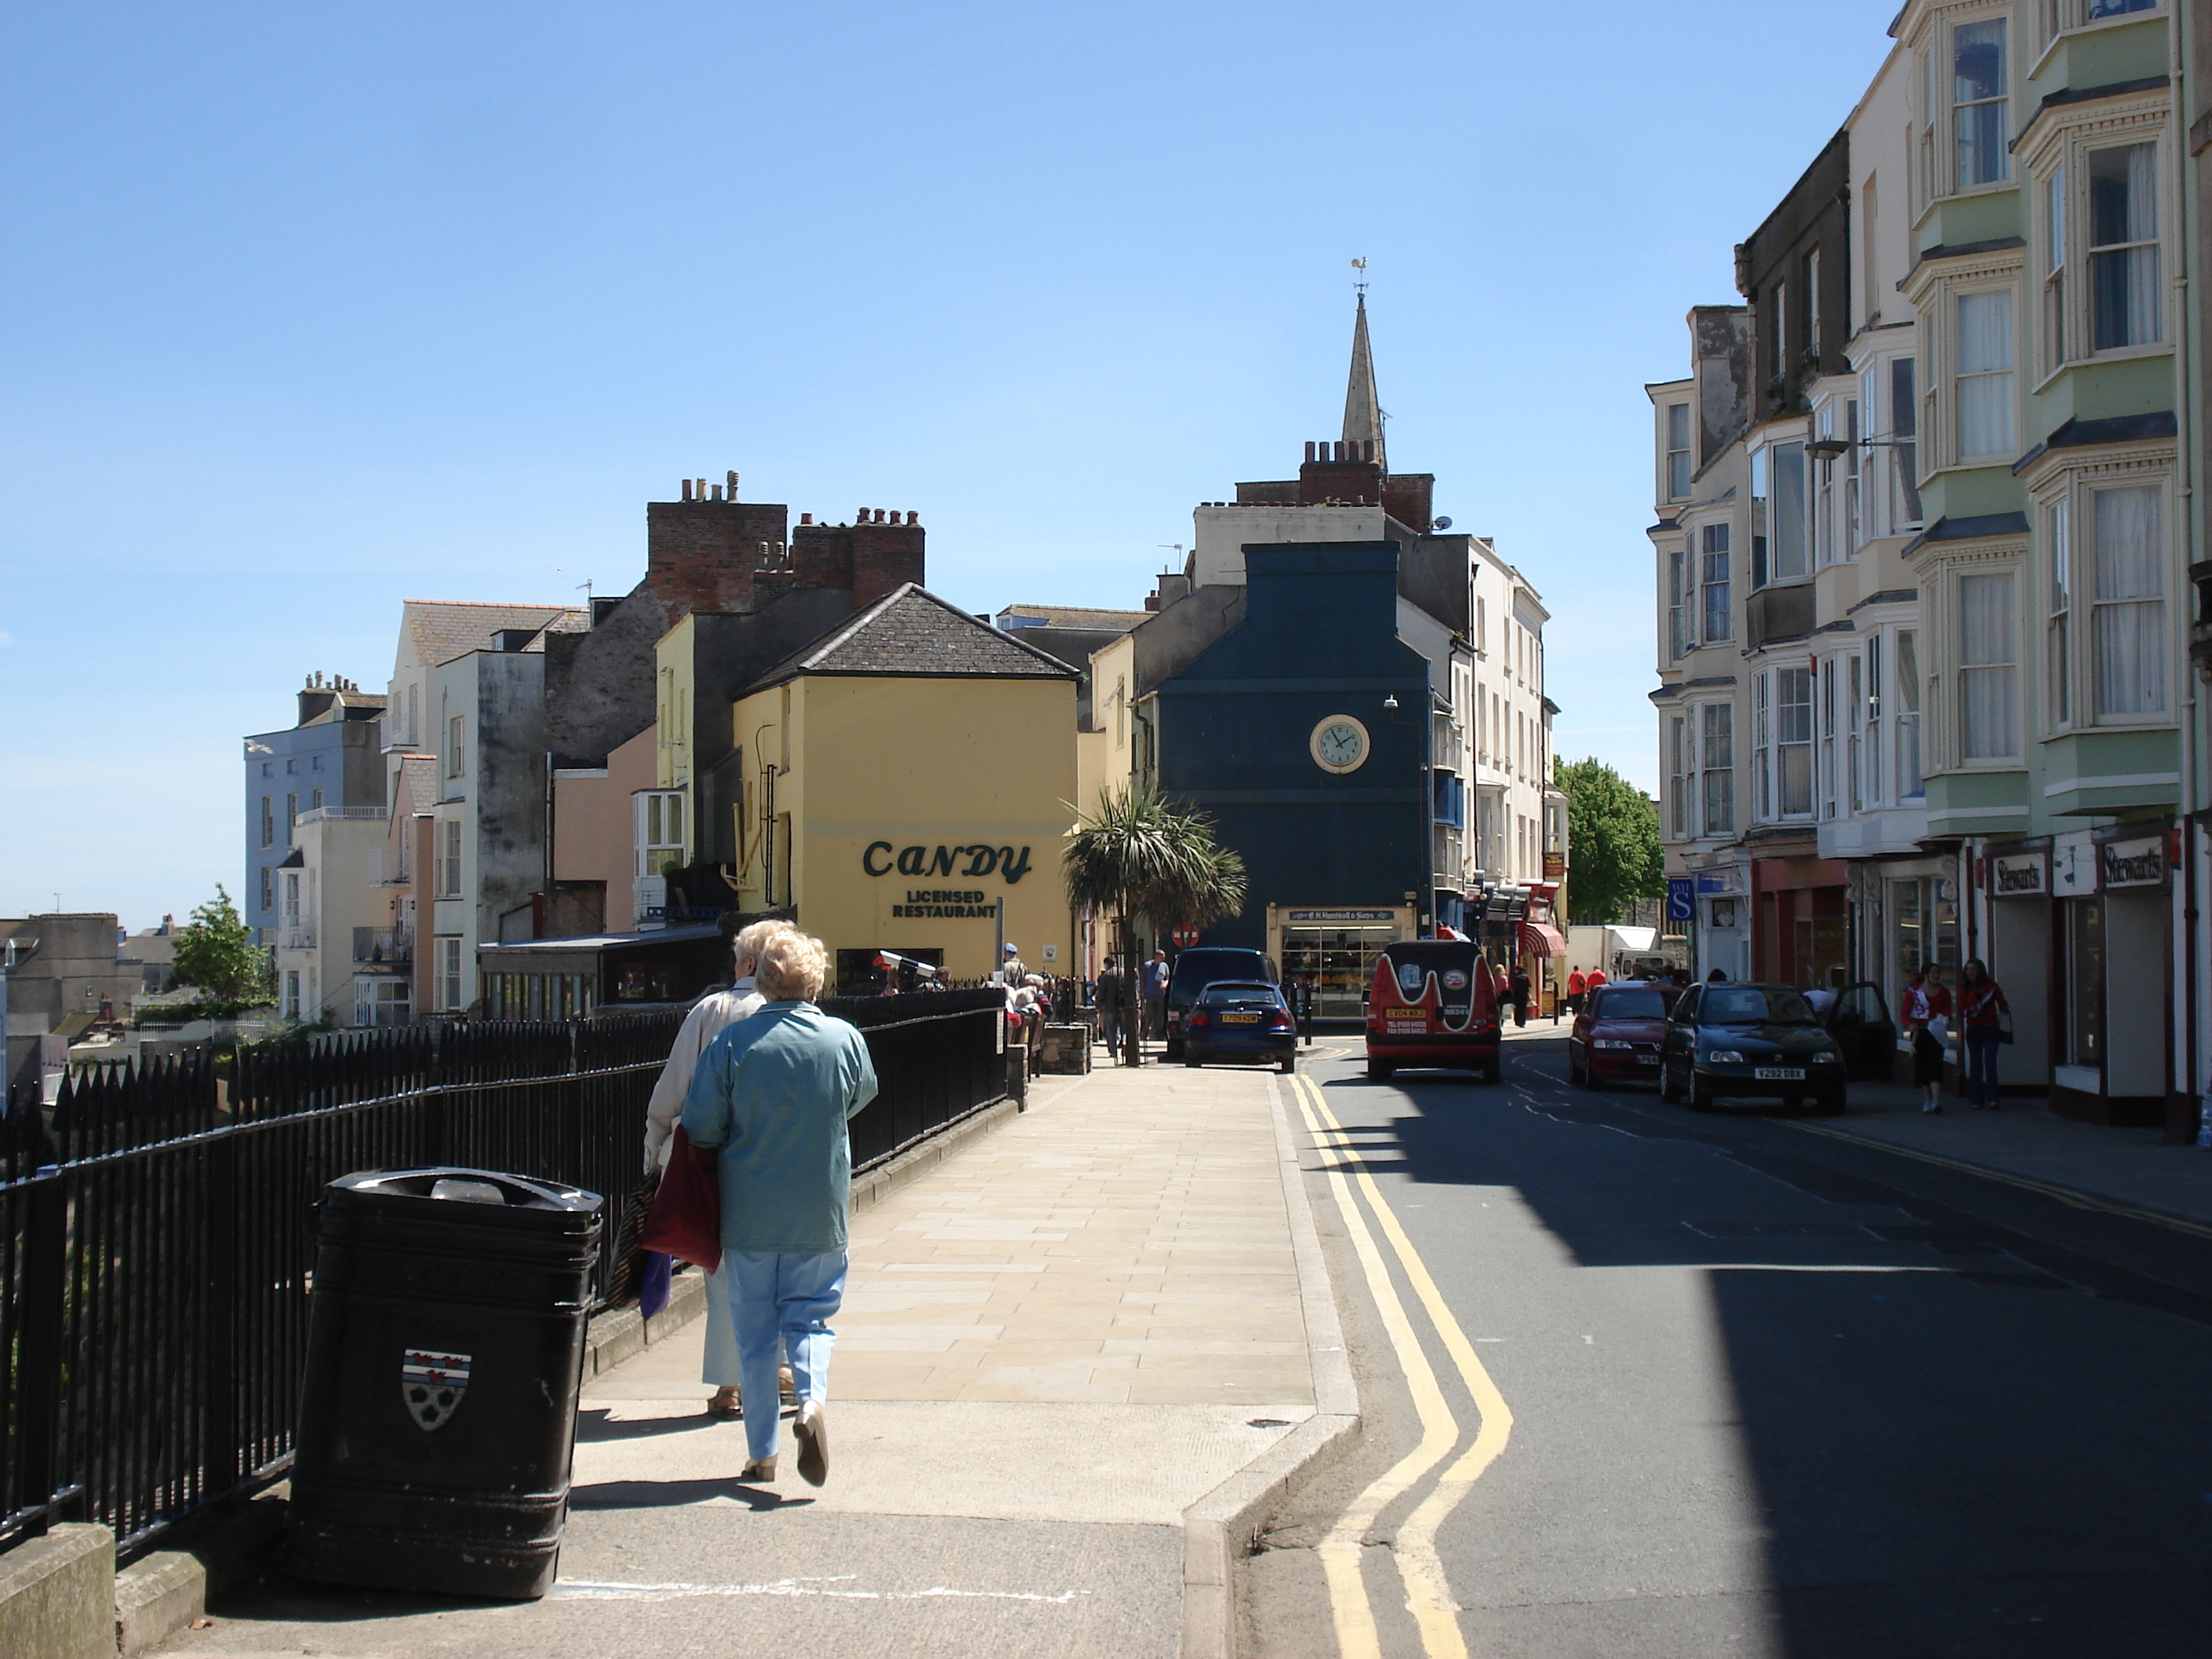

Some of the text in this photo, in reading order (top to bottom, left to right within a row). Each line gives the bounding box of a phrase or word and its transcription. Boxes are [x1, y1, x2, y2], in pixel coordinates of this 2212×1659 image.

[863, 841, 1032, 884] CANDY
[1672, 883, 1689, 892] WH
[907, 890, 984, 903] LICENSED
[892, 905, 996, 918] RESTAURANT
[1672, 892, 1691, 919] S
[1759, 1069, 1782, 1078] V292
